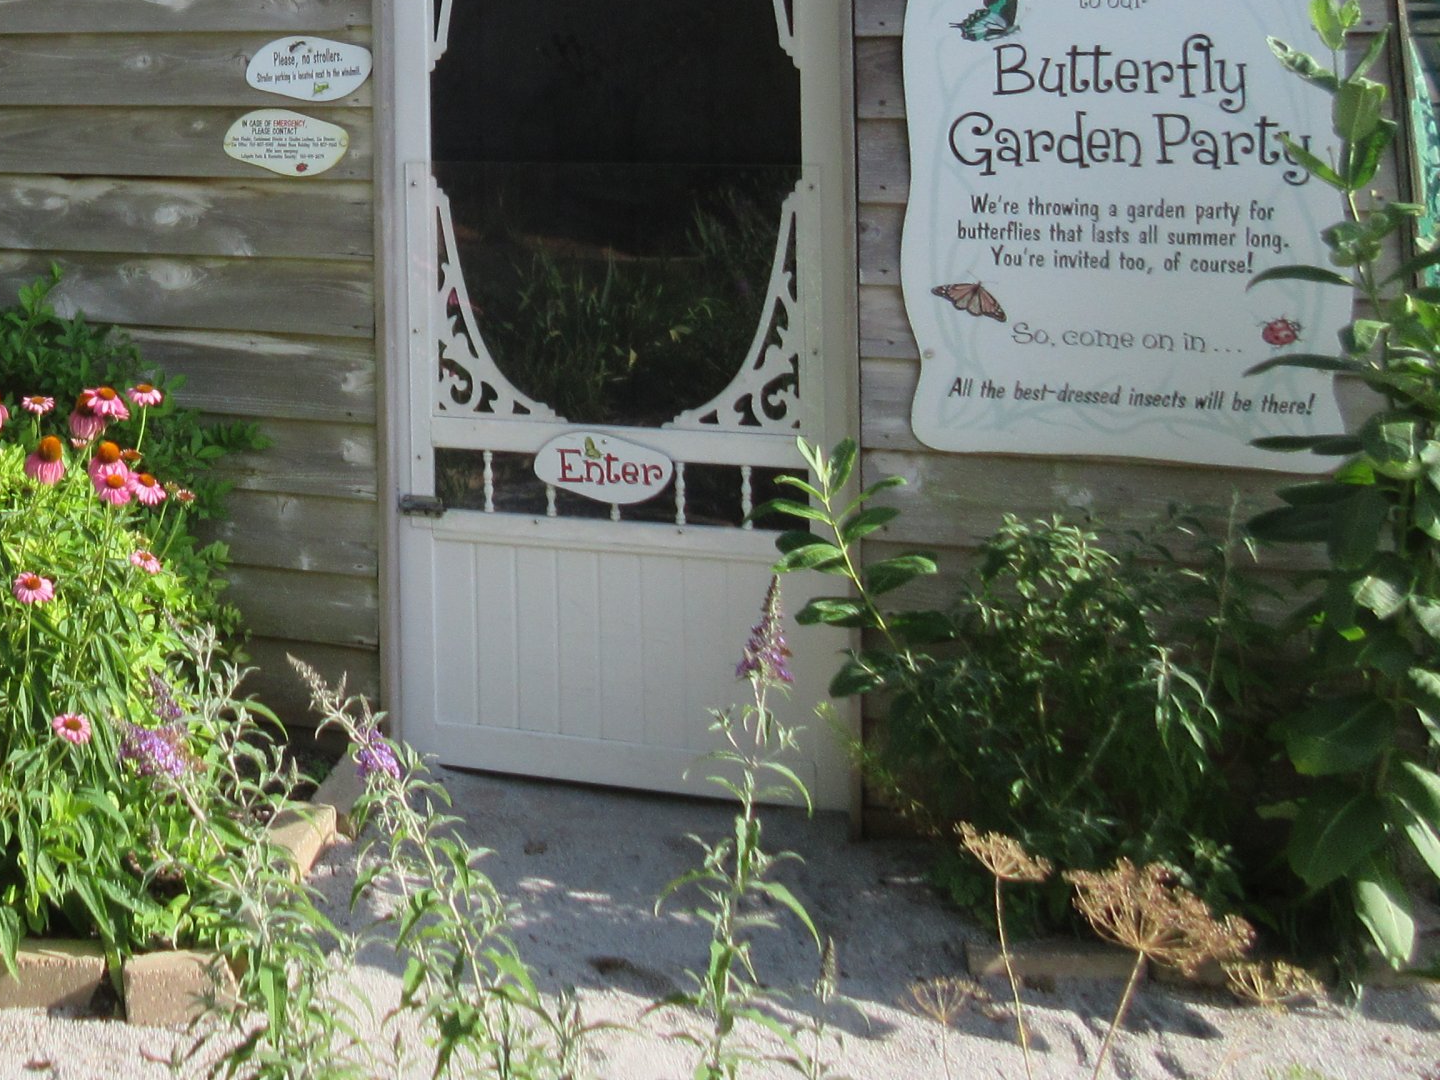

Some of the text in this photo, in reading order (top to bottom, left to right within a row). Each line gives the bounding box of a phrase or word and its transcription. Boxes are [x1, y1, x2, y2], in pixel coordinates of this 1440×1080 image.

[273, 48, 343, 69] Please, no strollers.
[992, 33, 1247, 114] Butterfly
[252, 127, 271, 135] PLEASE
[264, 119, 272, 127] OF
[948, 111, 1312, 186] Garden Party
[970, 194, 1275, 227] We're throwing a garden party for
[957, 220, 1290, 254] butterflies that lasts all summer long.
[990, 245, 1254, 275] You're invited too, of course!
[1011, 322, 1055, 348] So,
[1062, 329, 1135, 350] come
[1141, 333, 1175, 353] on
[948, 377, 1316, 416] All the best-dressed insects will be there!
[556, 448, 663, 486] Enter
